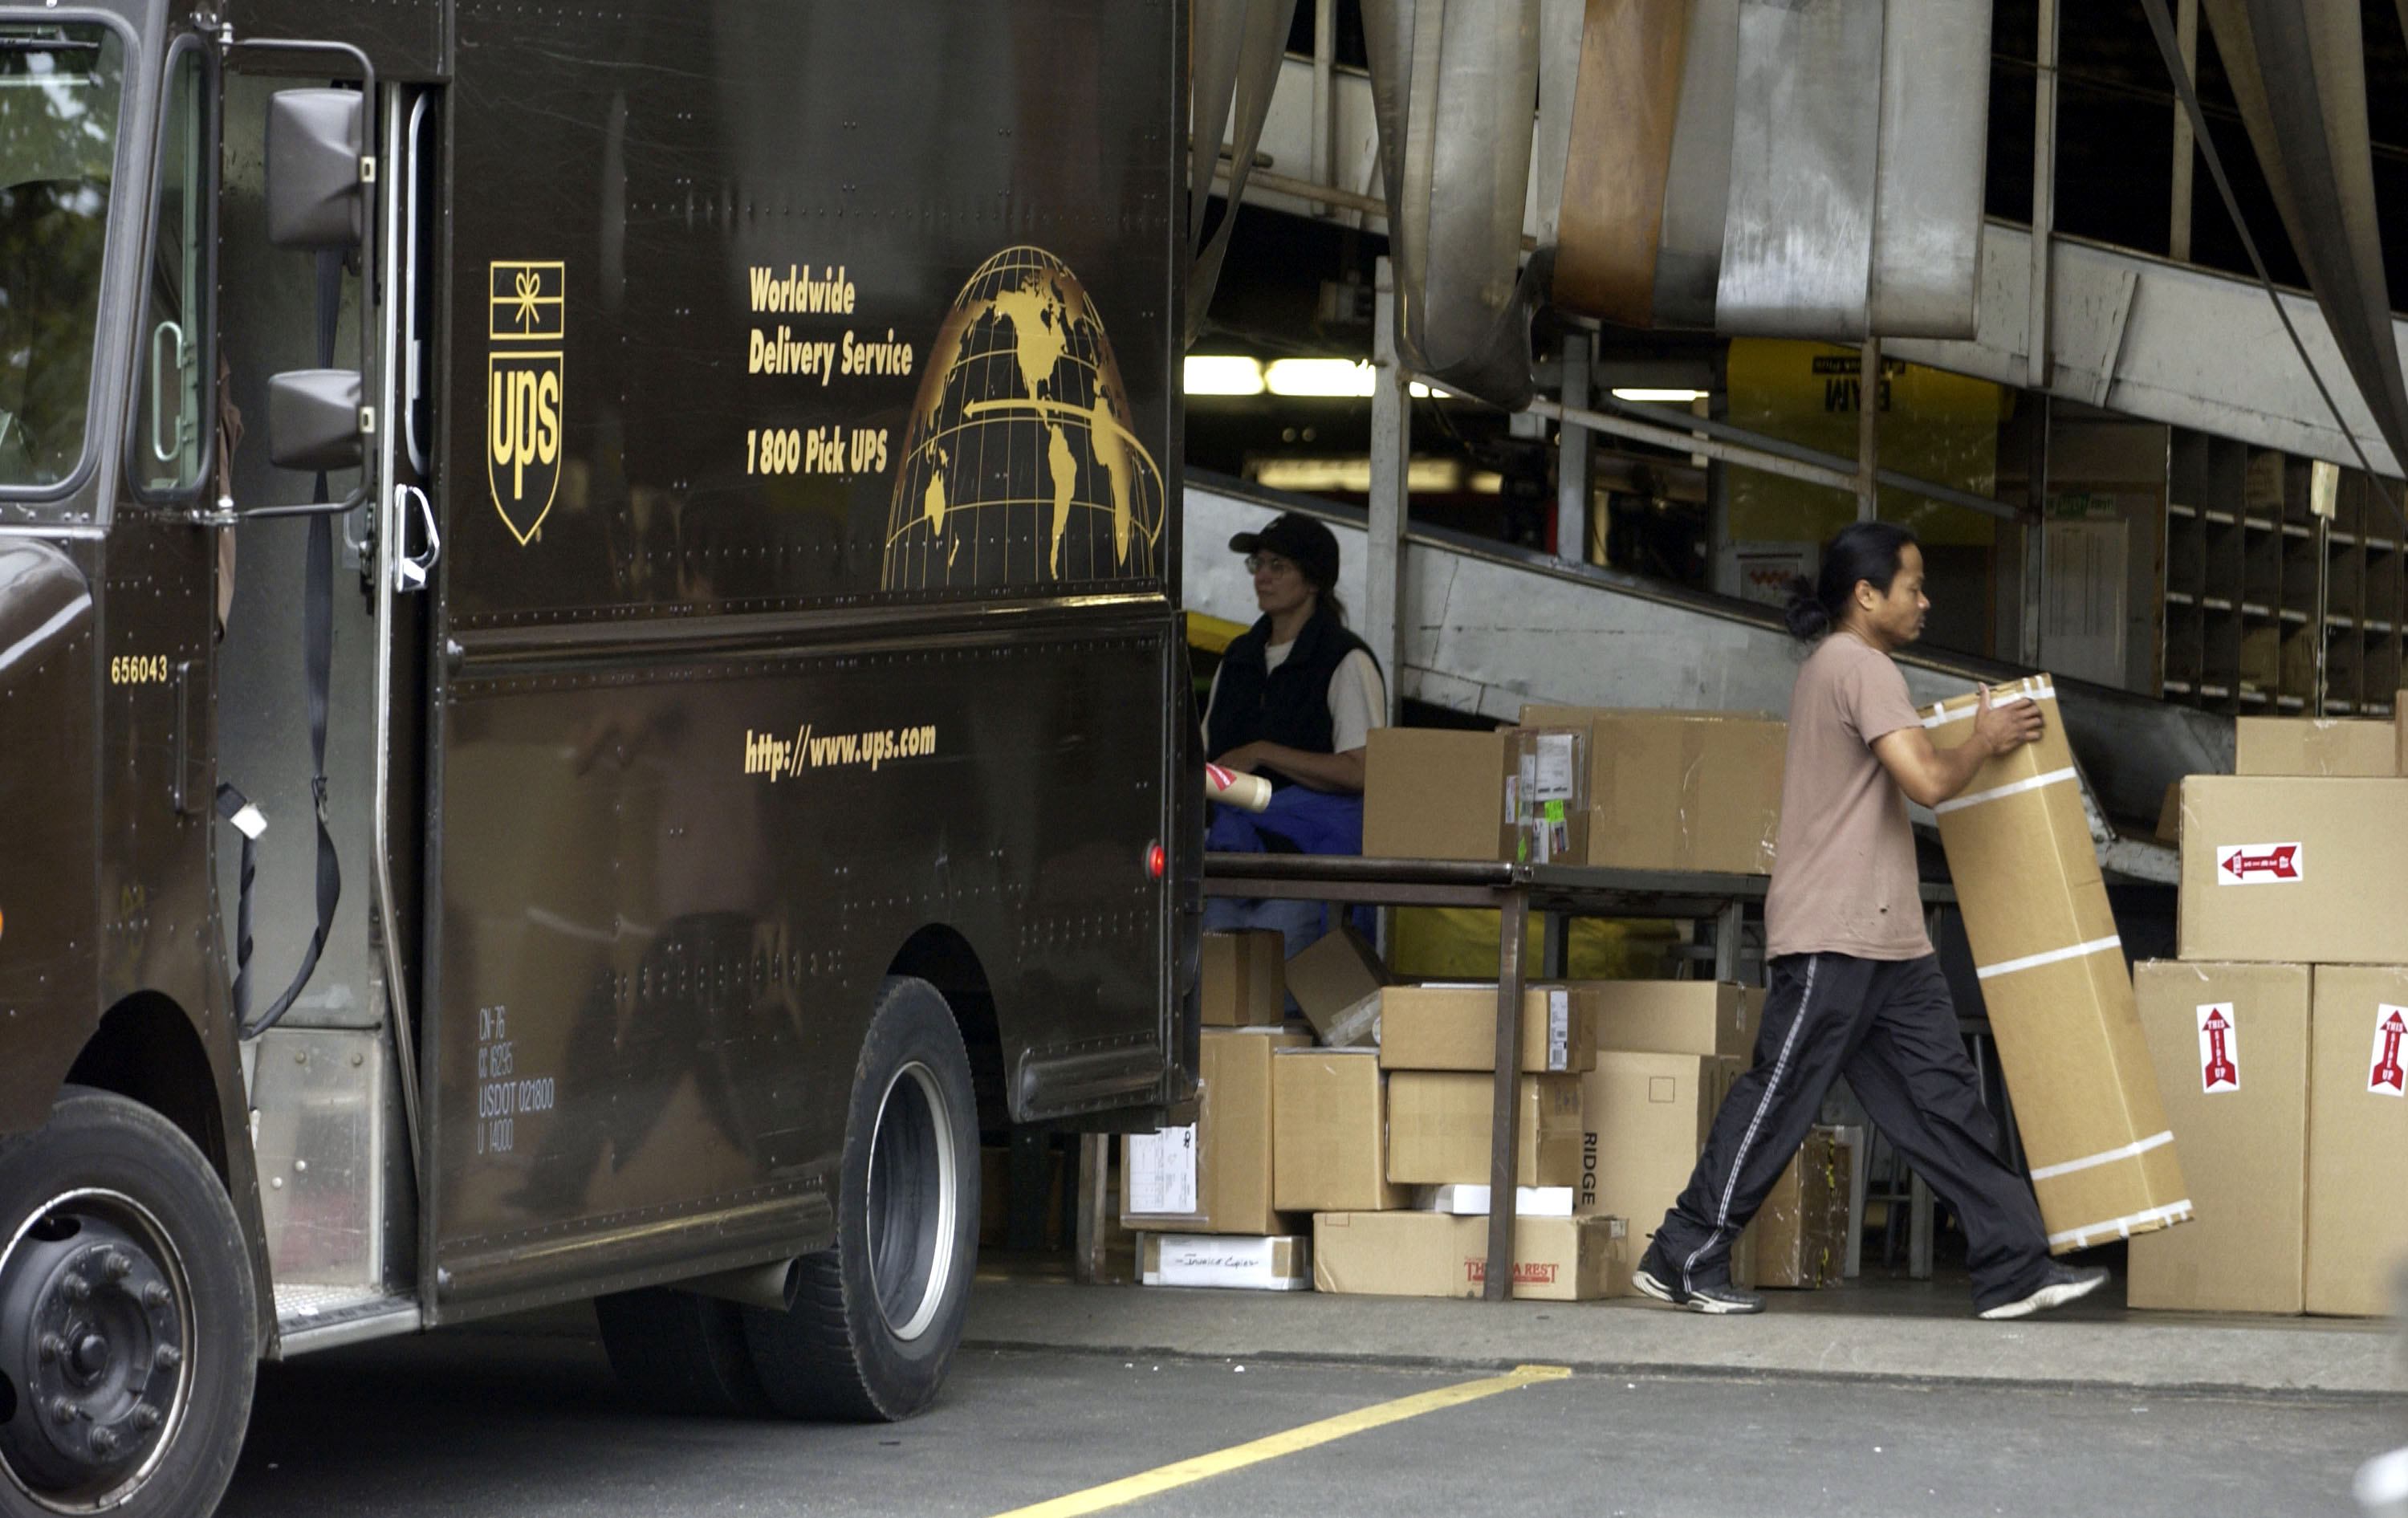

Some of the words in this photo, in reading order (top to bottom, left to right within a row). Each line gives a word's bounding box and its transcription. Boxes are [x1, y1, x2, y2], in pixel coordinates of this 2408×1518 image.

[750, 264, 856, 314] Worldwide
[748, 325, 836, 386] Delivery
[841, 328, 913, 375] Service
[805, 425, 845, 473] Pick
[851, 429, 888, 473] UPS
[111, 655, 168, 684] 656043
[745, 724, 937, 783] http://www.ups.com
[2207, 1019, 2225, 1030] THIS
[2215, 1067, 2226, 1078] UP
[2382, 1068, 2394, 1081] UP
[479, 1081, 517, 1118] USDOT
[519, 1076, 555, 1113] 021800
[1582, 1132, 1597, 1206] RIDGE
